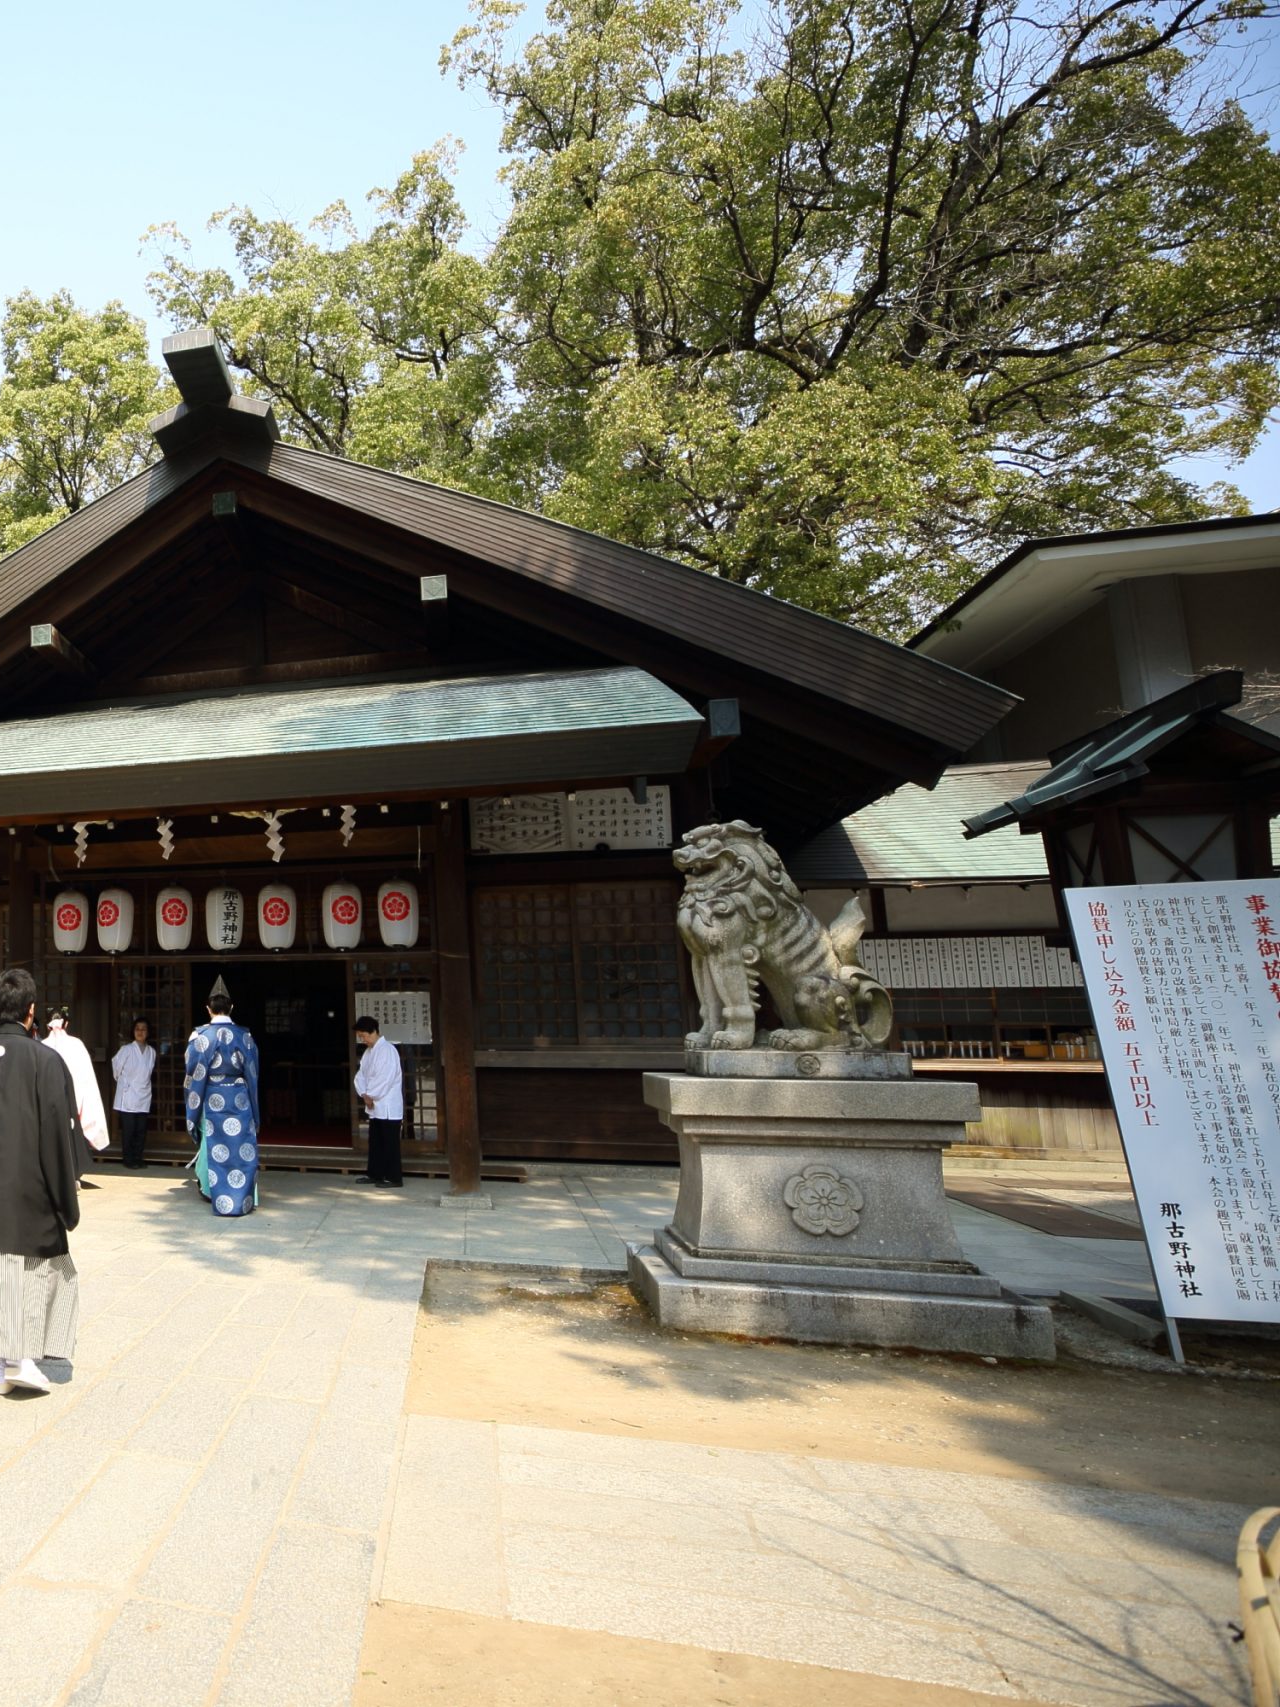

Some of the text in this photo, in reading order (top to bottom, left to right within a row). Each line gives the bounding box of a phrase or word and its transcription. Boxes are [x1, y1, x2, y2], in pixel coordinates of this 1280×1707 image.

[221, 890, 238, 945] 那古野神社
[1087, 900, 1160, 1127] 協賛申し込み金額 五千円以上
[1160, 1202, 1203, 1298] 那古野神社
